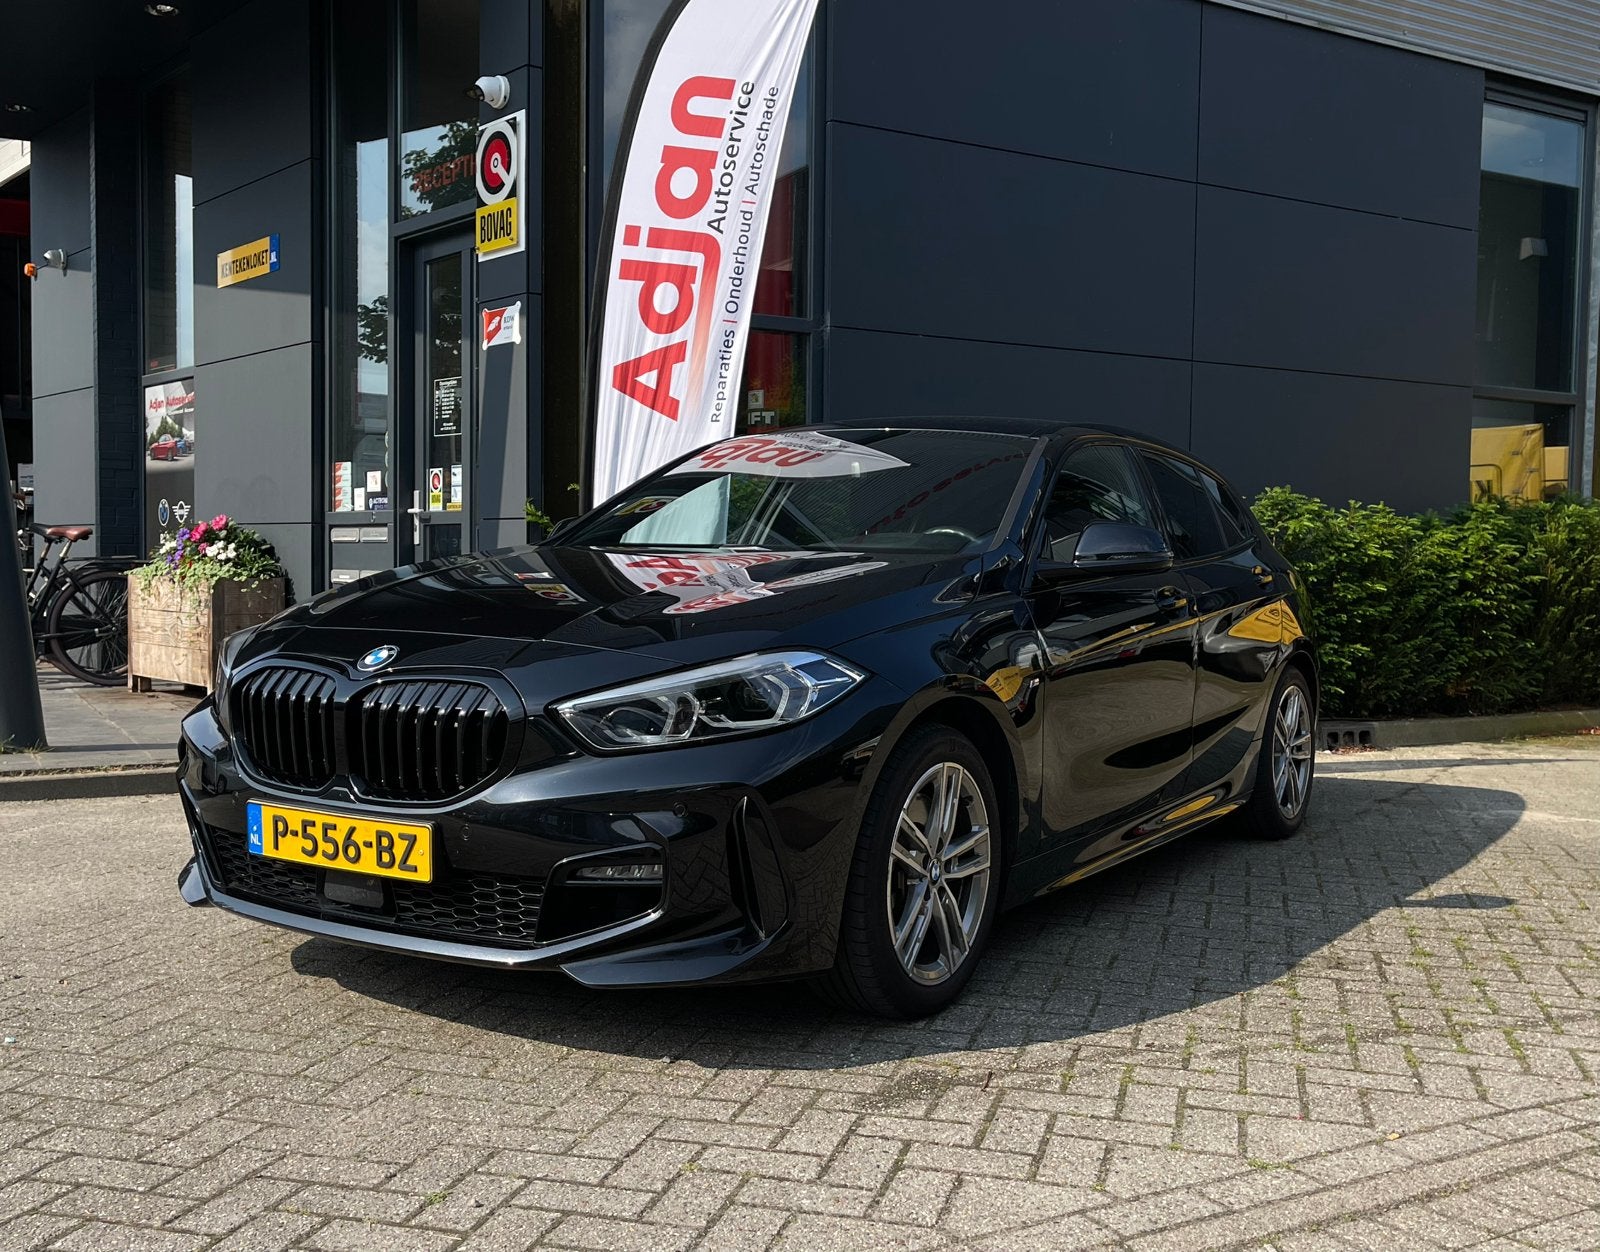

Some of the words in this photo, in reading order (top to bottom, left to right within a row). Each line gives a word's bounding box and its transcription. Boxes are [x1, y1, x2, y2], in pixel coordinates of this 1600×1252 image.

[706, 81, 755, 235] Autoservice
[480, 206, 512, 244] BOVAG
[612, 76, 737, 422] Adjan
[711, 328, 736, 423] Reparaties
[725, 209, 753, 315] Onderhoud
[746, 86, 779, 196] Autoschade
[221, 249, 268, 279] KENTEKENLOKET
[250, 832, 262, 846] NL
[272, 814, 418, 873] P-556-BZ
